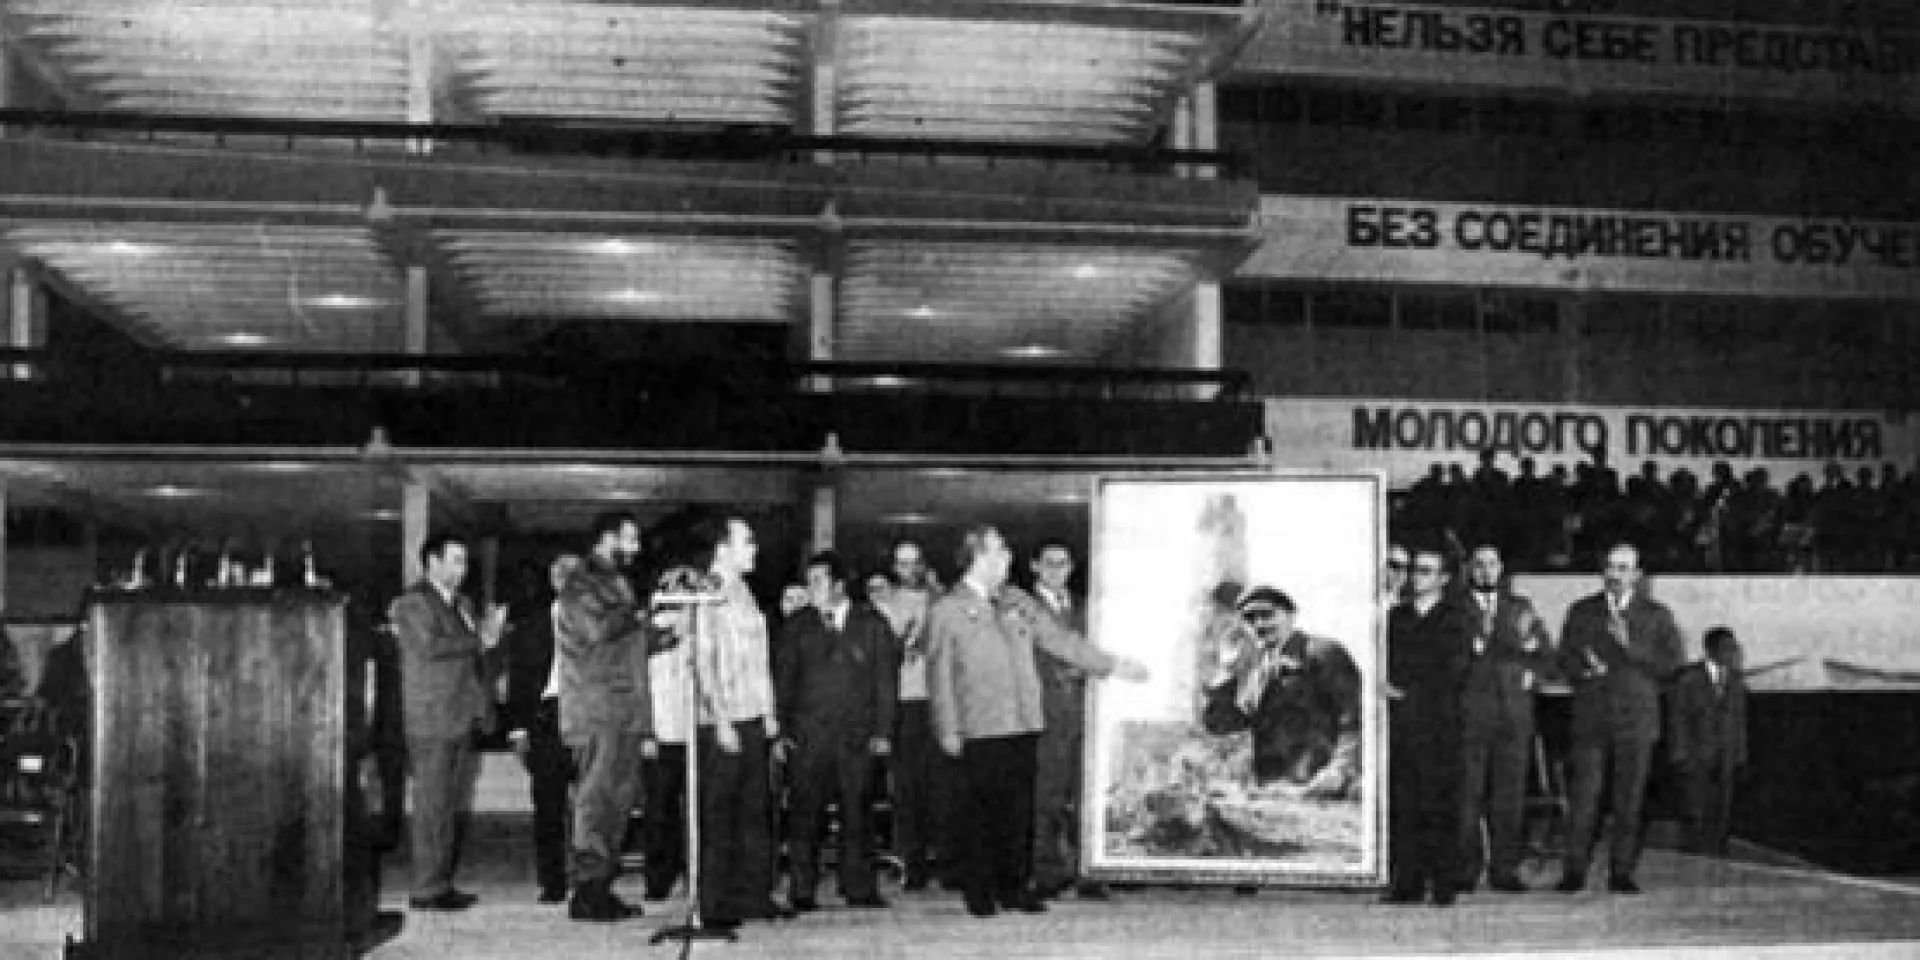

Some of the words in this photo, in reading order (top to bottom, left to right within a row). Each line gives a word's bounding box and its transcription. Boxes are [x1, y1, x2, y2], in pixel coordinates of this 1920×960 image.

[1541, 20, 1658, 63] СЕБЕ
[1346, 205, 1442, 249] БЕЗ
[1455, 210, 1751, 263] СОЕДИНЕНИЯ
[1771, 220, 1920, 268] ОБУЧЕ
[1351, 407, 1607, 457] МОЛОДОГО
